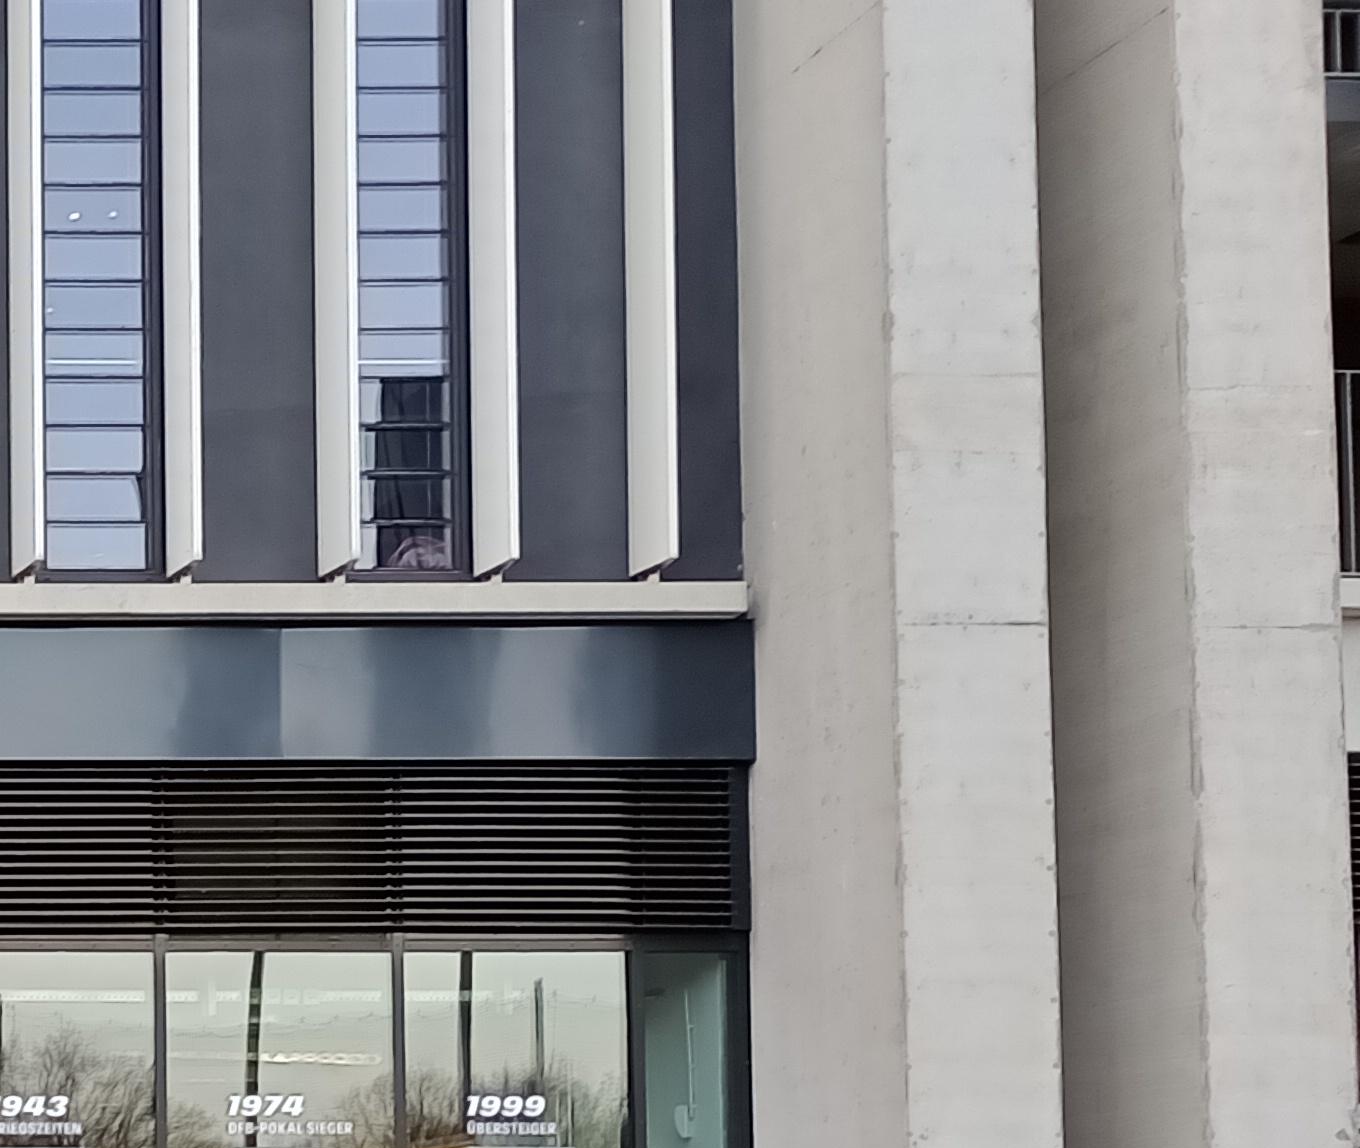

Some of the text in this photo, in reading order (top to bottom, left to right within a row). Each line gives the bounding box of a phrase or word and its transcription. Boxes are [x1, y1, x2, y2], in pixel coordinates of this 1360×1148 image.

[228, 1095, 305, 1117] 1974
[466, 1095, 546, 1118] 1999
[228, 1121, 354, 1135] DFB-POKAL SIEGER
[466, 1120, 557, 1135] ÜBERSTEIGER
